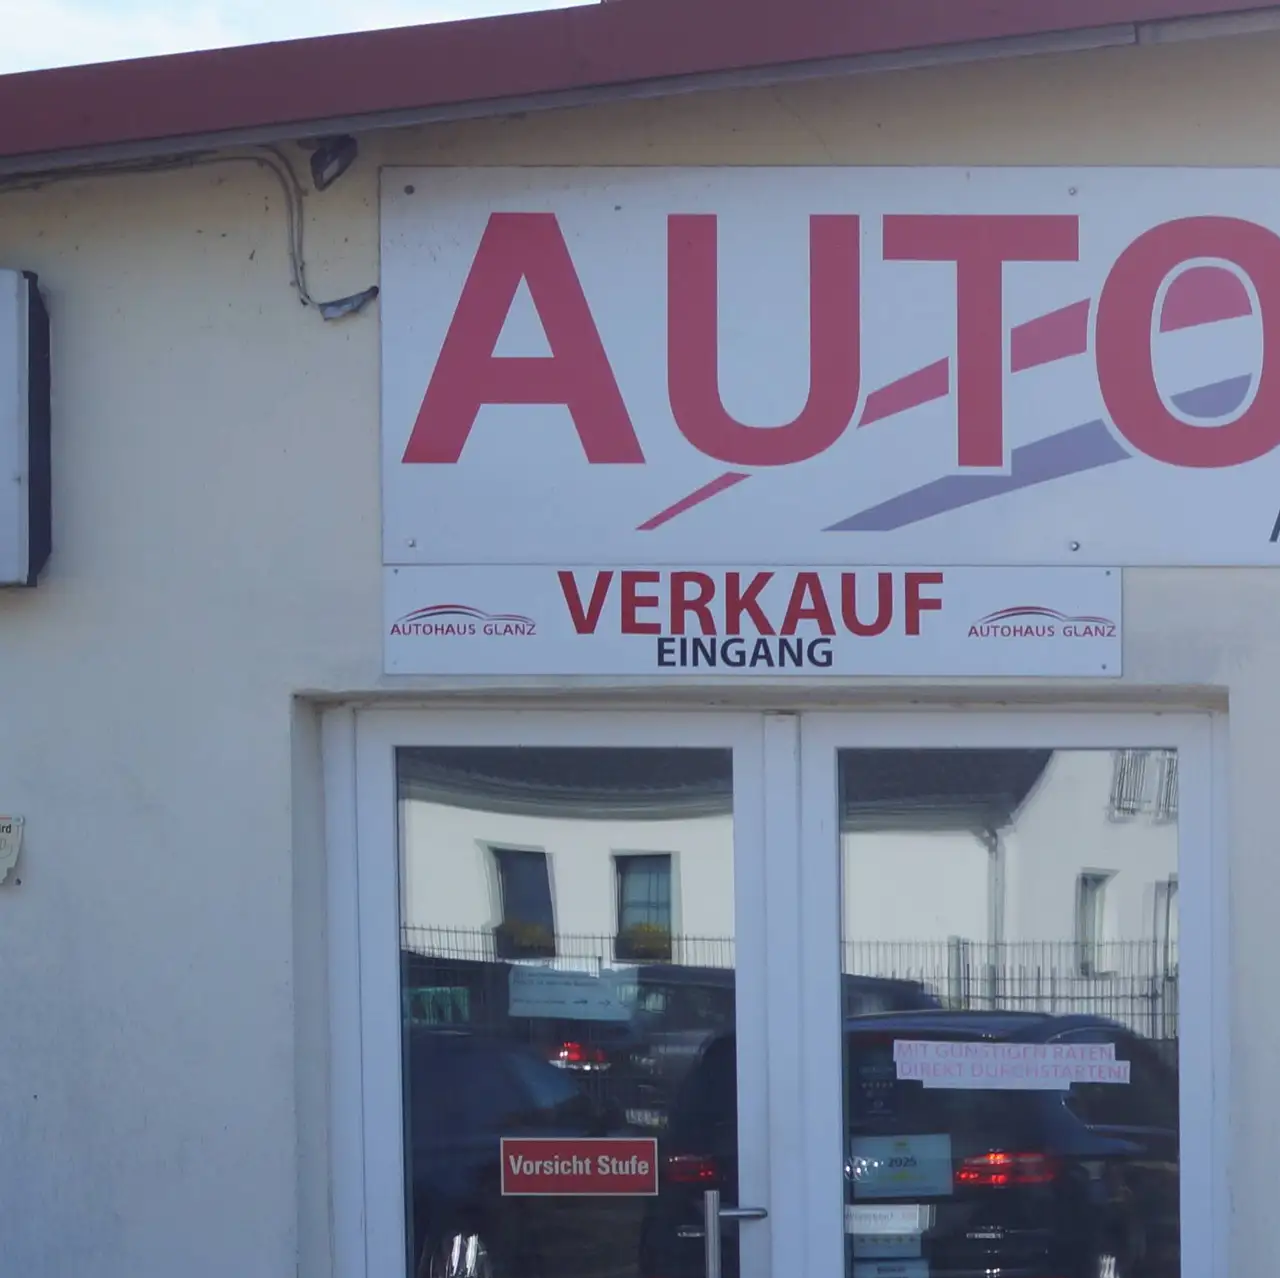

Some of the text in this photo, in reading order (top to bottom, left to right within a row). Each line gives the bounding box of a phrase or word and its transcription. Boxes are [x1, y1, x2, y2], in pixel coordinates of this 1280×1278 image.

[557, 570, 944, 637] VERKAUF
[390, 623, 537, 637] AUTOHAUS GLANZ
[968, 625, 1117, 639] AUTOHAUS GLANZ
[657, 637, 834, 668] EINGANG
[898, 1043, 928, 1057] MIT
[509, 1155, 649, 1175] Vorsicht Stufe
